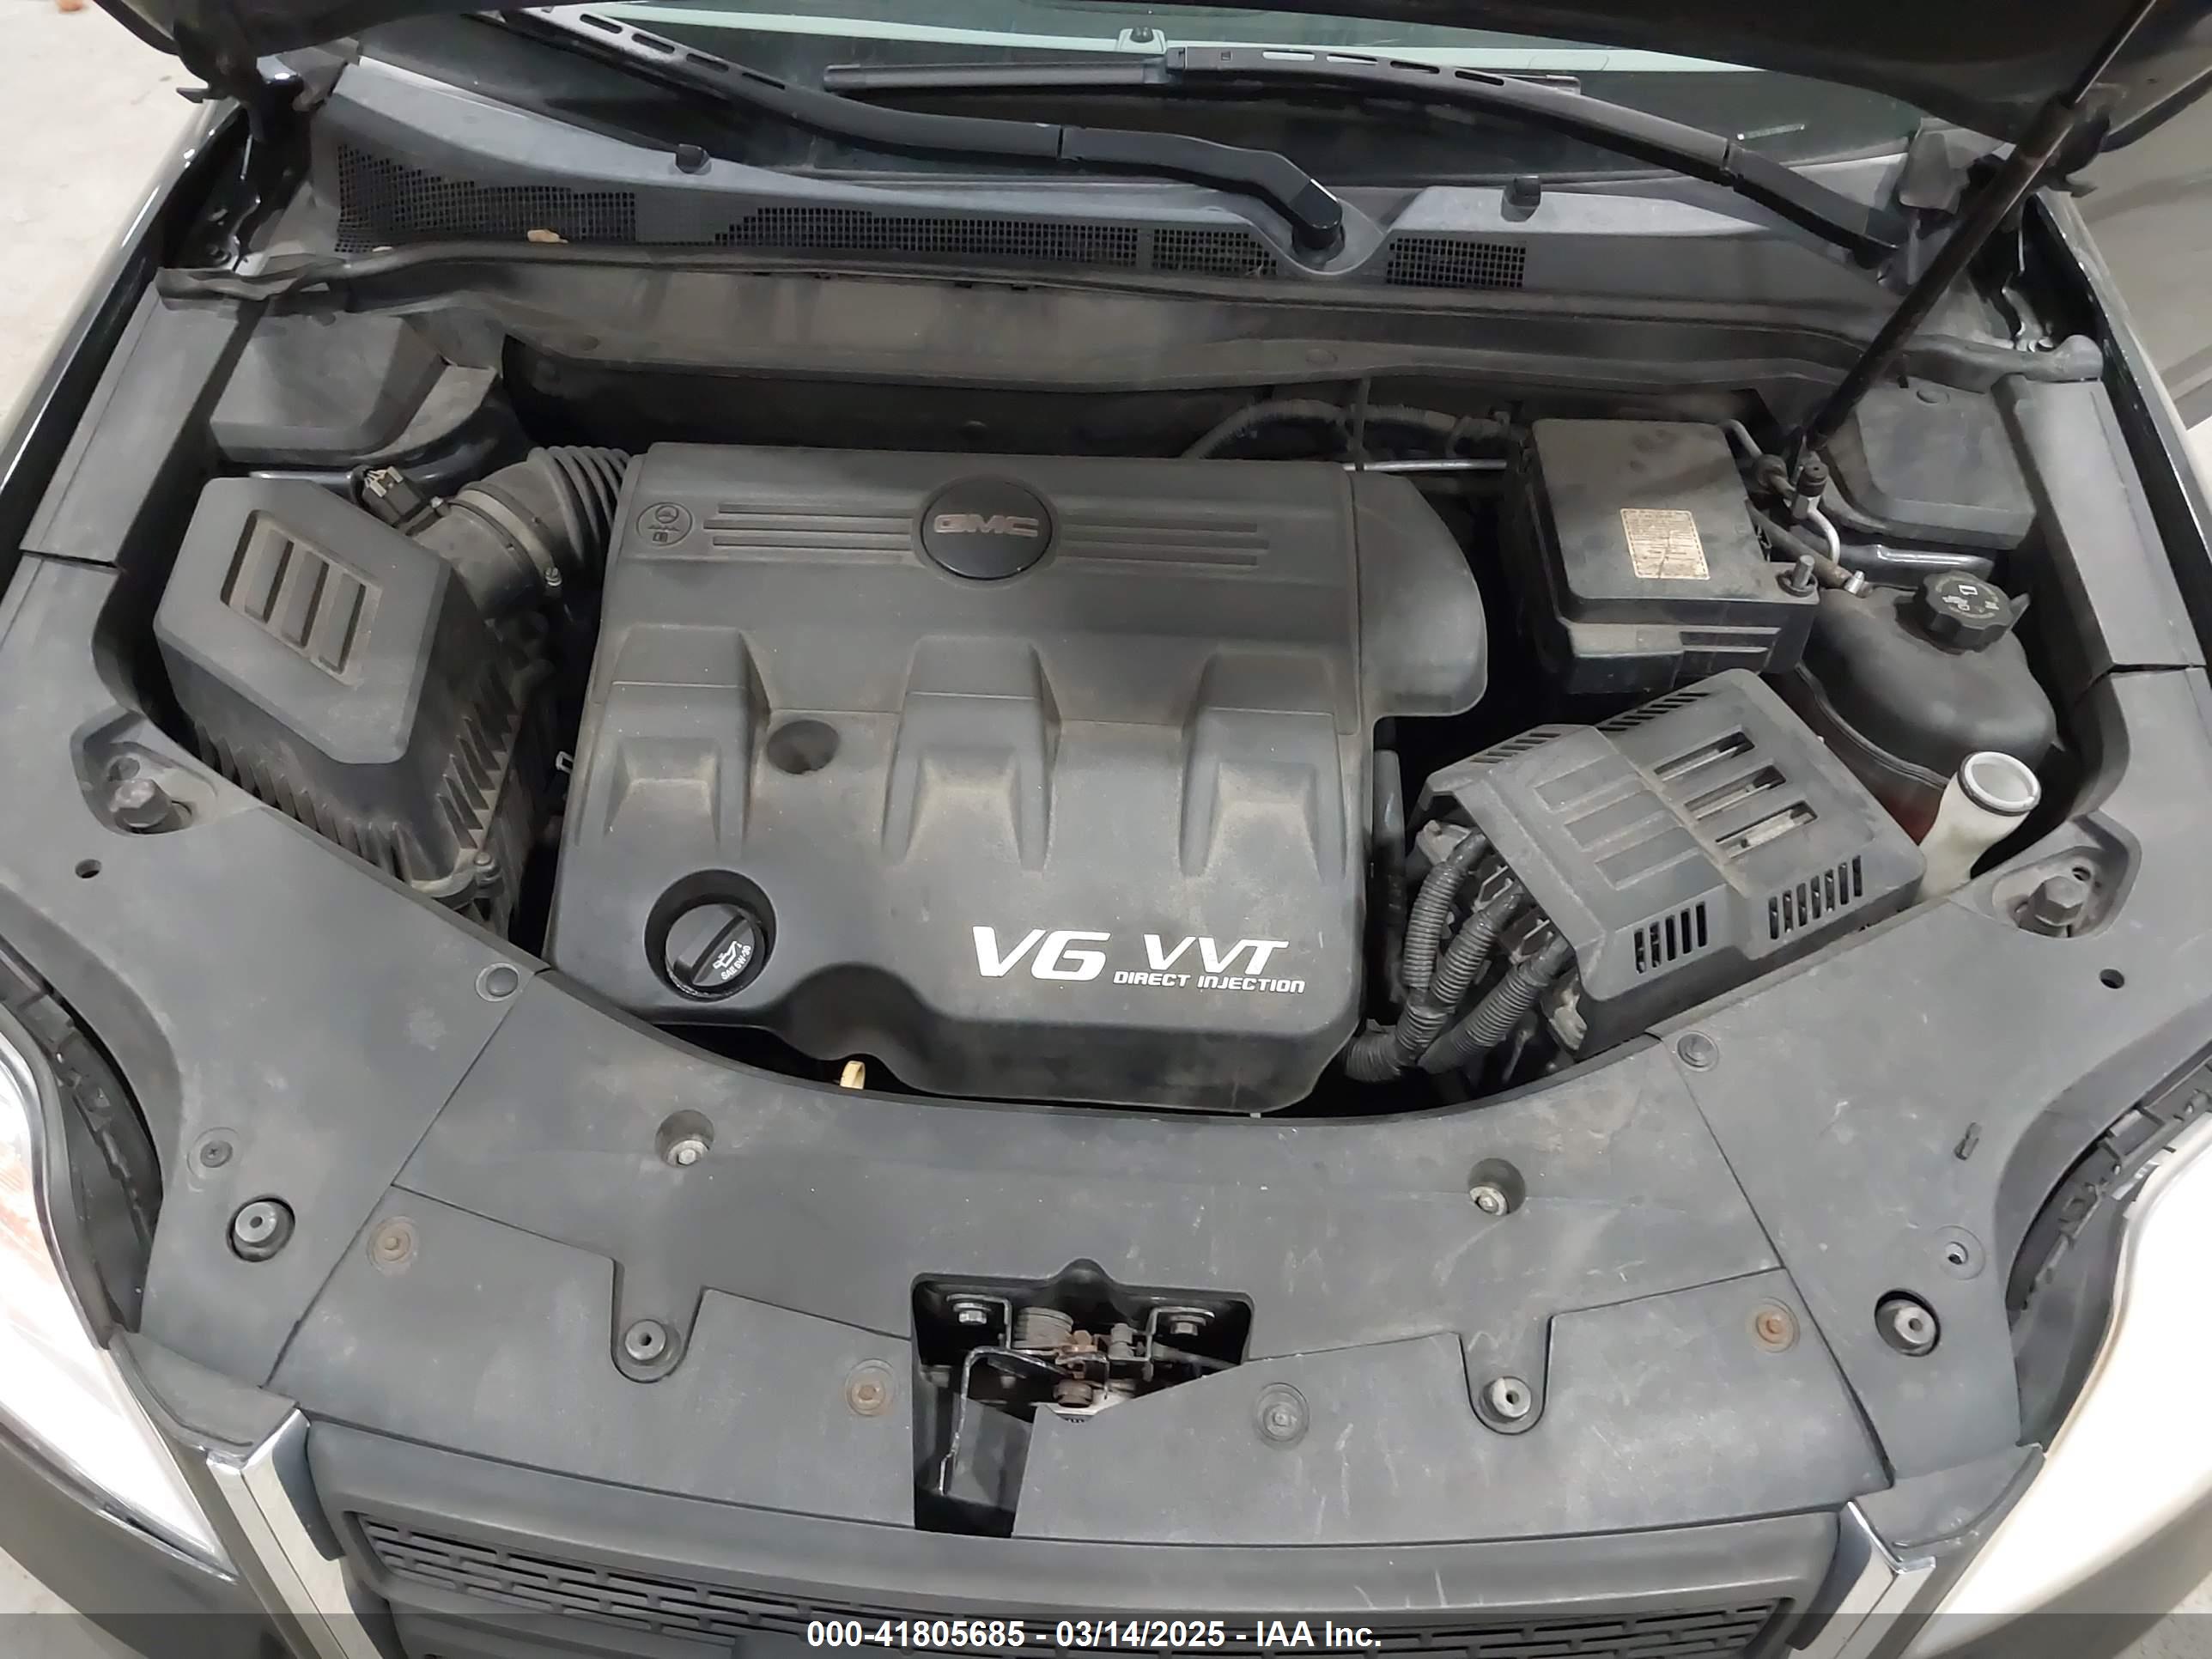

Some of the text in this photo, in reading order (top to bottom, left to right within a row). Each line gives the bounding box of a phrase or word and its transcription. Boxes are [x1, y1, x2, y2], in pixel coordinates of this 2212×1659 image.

[934, 514, 1039, 538] GMC
[973, 927, 1290, 981] V6 VVT
[720, 965, 737, 981] SAE
[1114, 971, 1306, 994] DIRECT INJECTION
